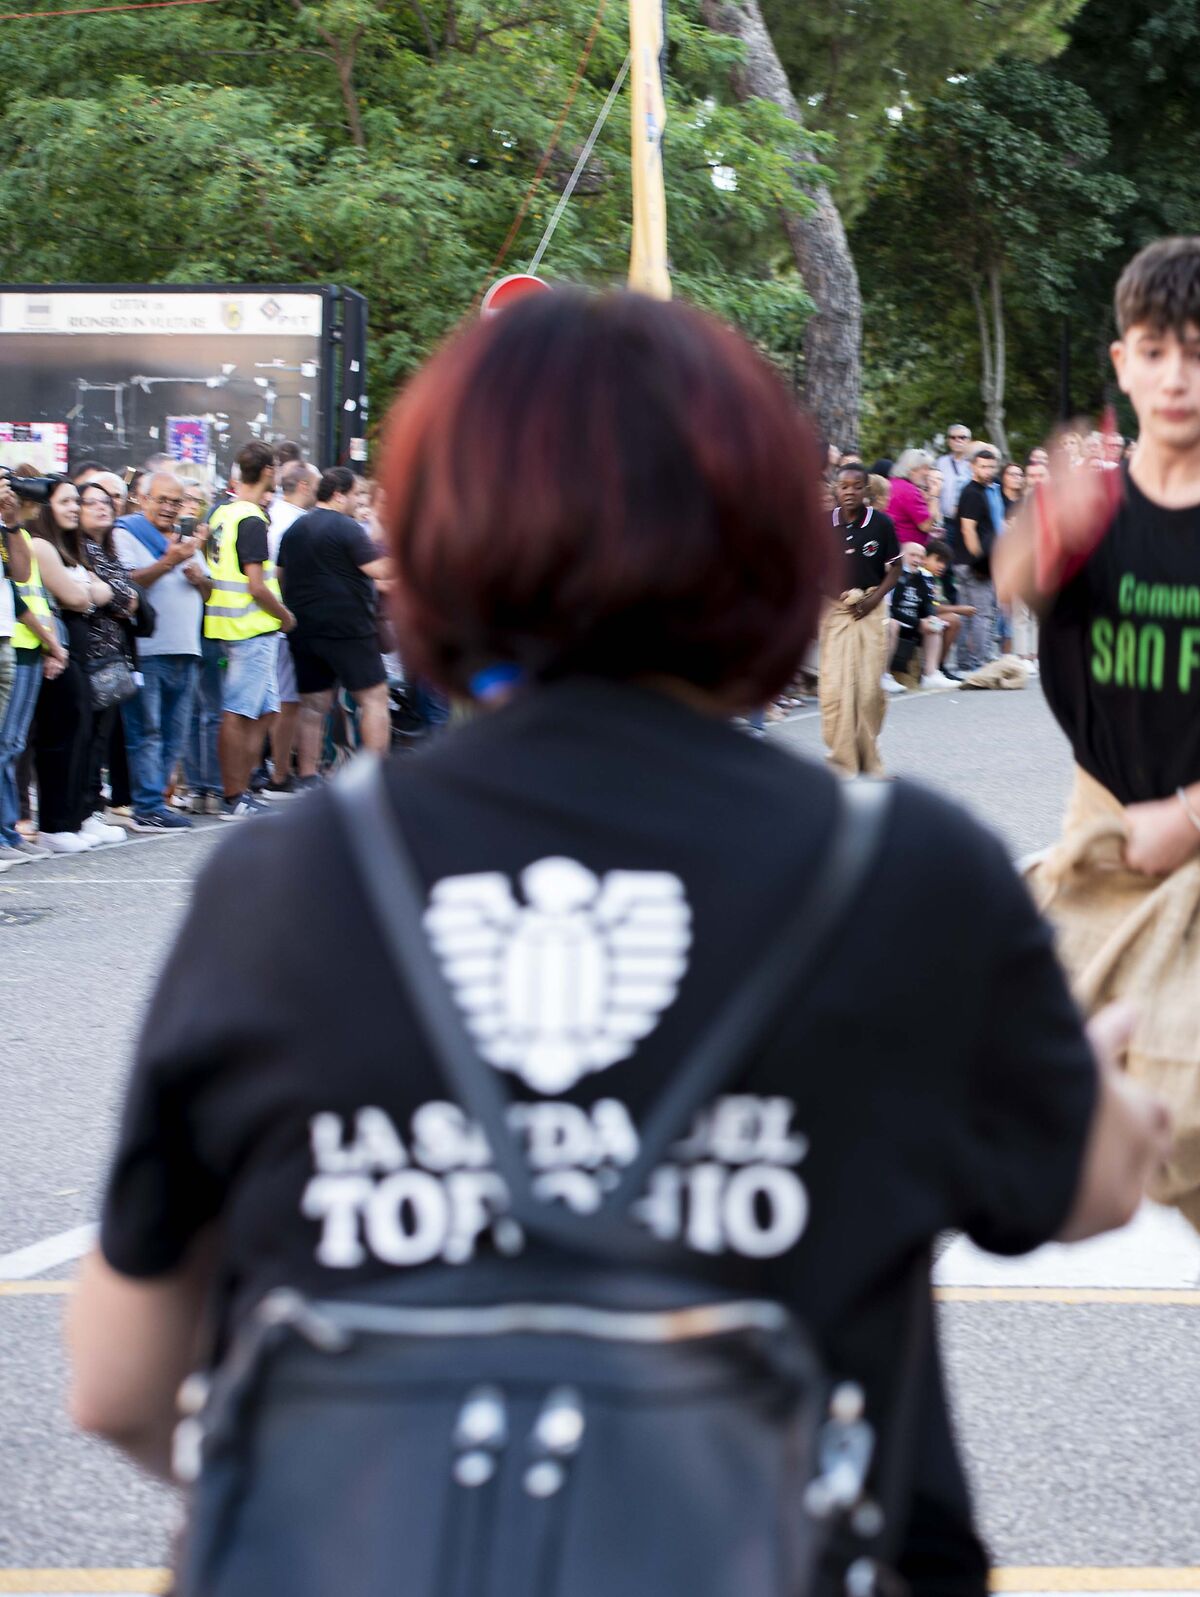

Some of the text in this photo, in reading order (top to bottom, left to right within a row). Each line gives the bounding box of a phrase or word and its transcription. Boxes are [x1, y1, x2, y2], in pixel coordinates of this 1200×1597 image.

[1091, 616, 1166, 692] SAN
[309, 1105, 409, 1173] LA
[676, 1095, 809, 1166] EL
